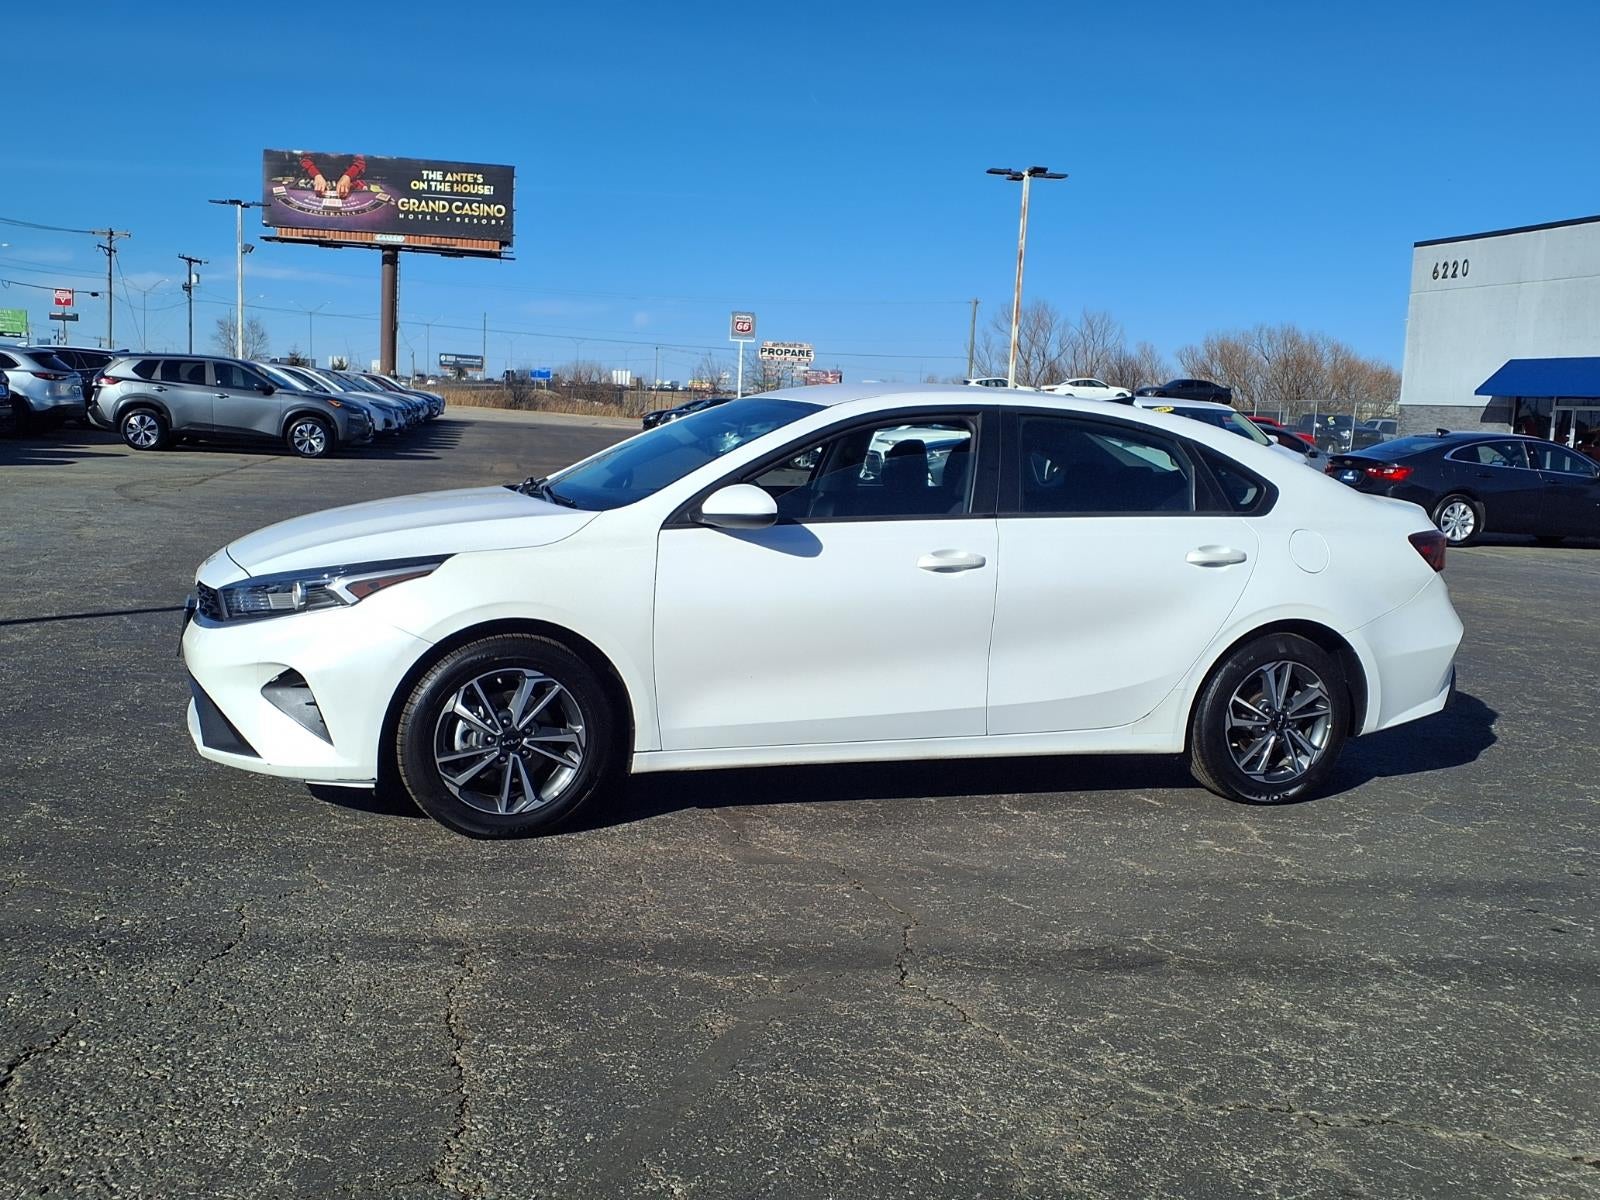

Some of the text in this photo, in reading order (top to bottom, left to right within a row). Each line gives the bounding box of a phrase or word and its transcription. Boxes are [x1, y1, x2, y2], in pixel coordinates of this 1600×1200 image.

[421, 170, 484, 183] THE ANTE'S
[410, 180, 495, 195] ON THE HOUSE!
[397, 198, 506, 217] GRAND CASINO
[399, 213, 505, 225] HOTEL RESORT
[1432, 259, 1469, 280] 6220
[736, 322, 750, 331] 66
[760, 347, 813, 358] PROPANE
